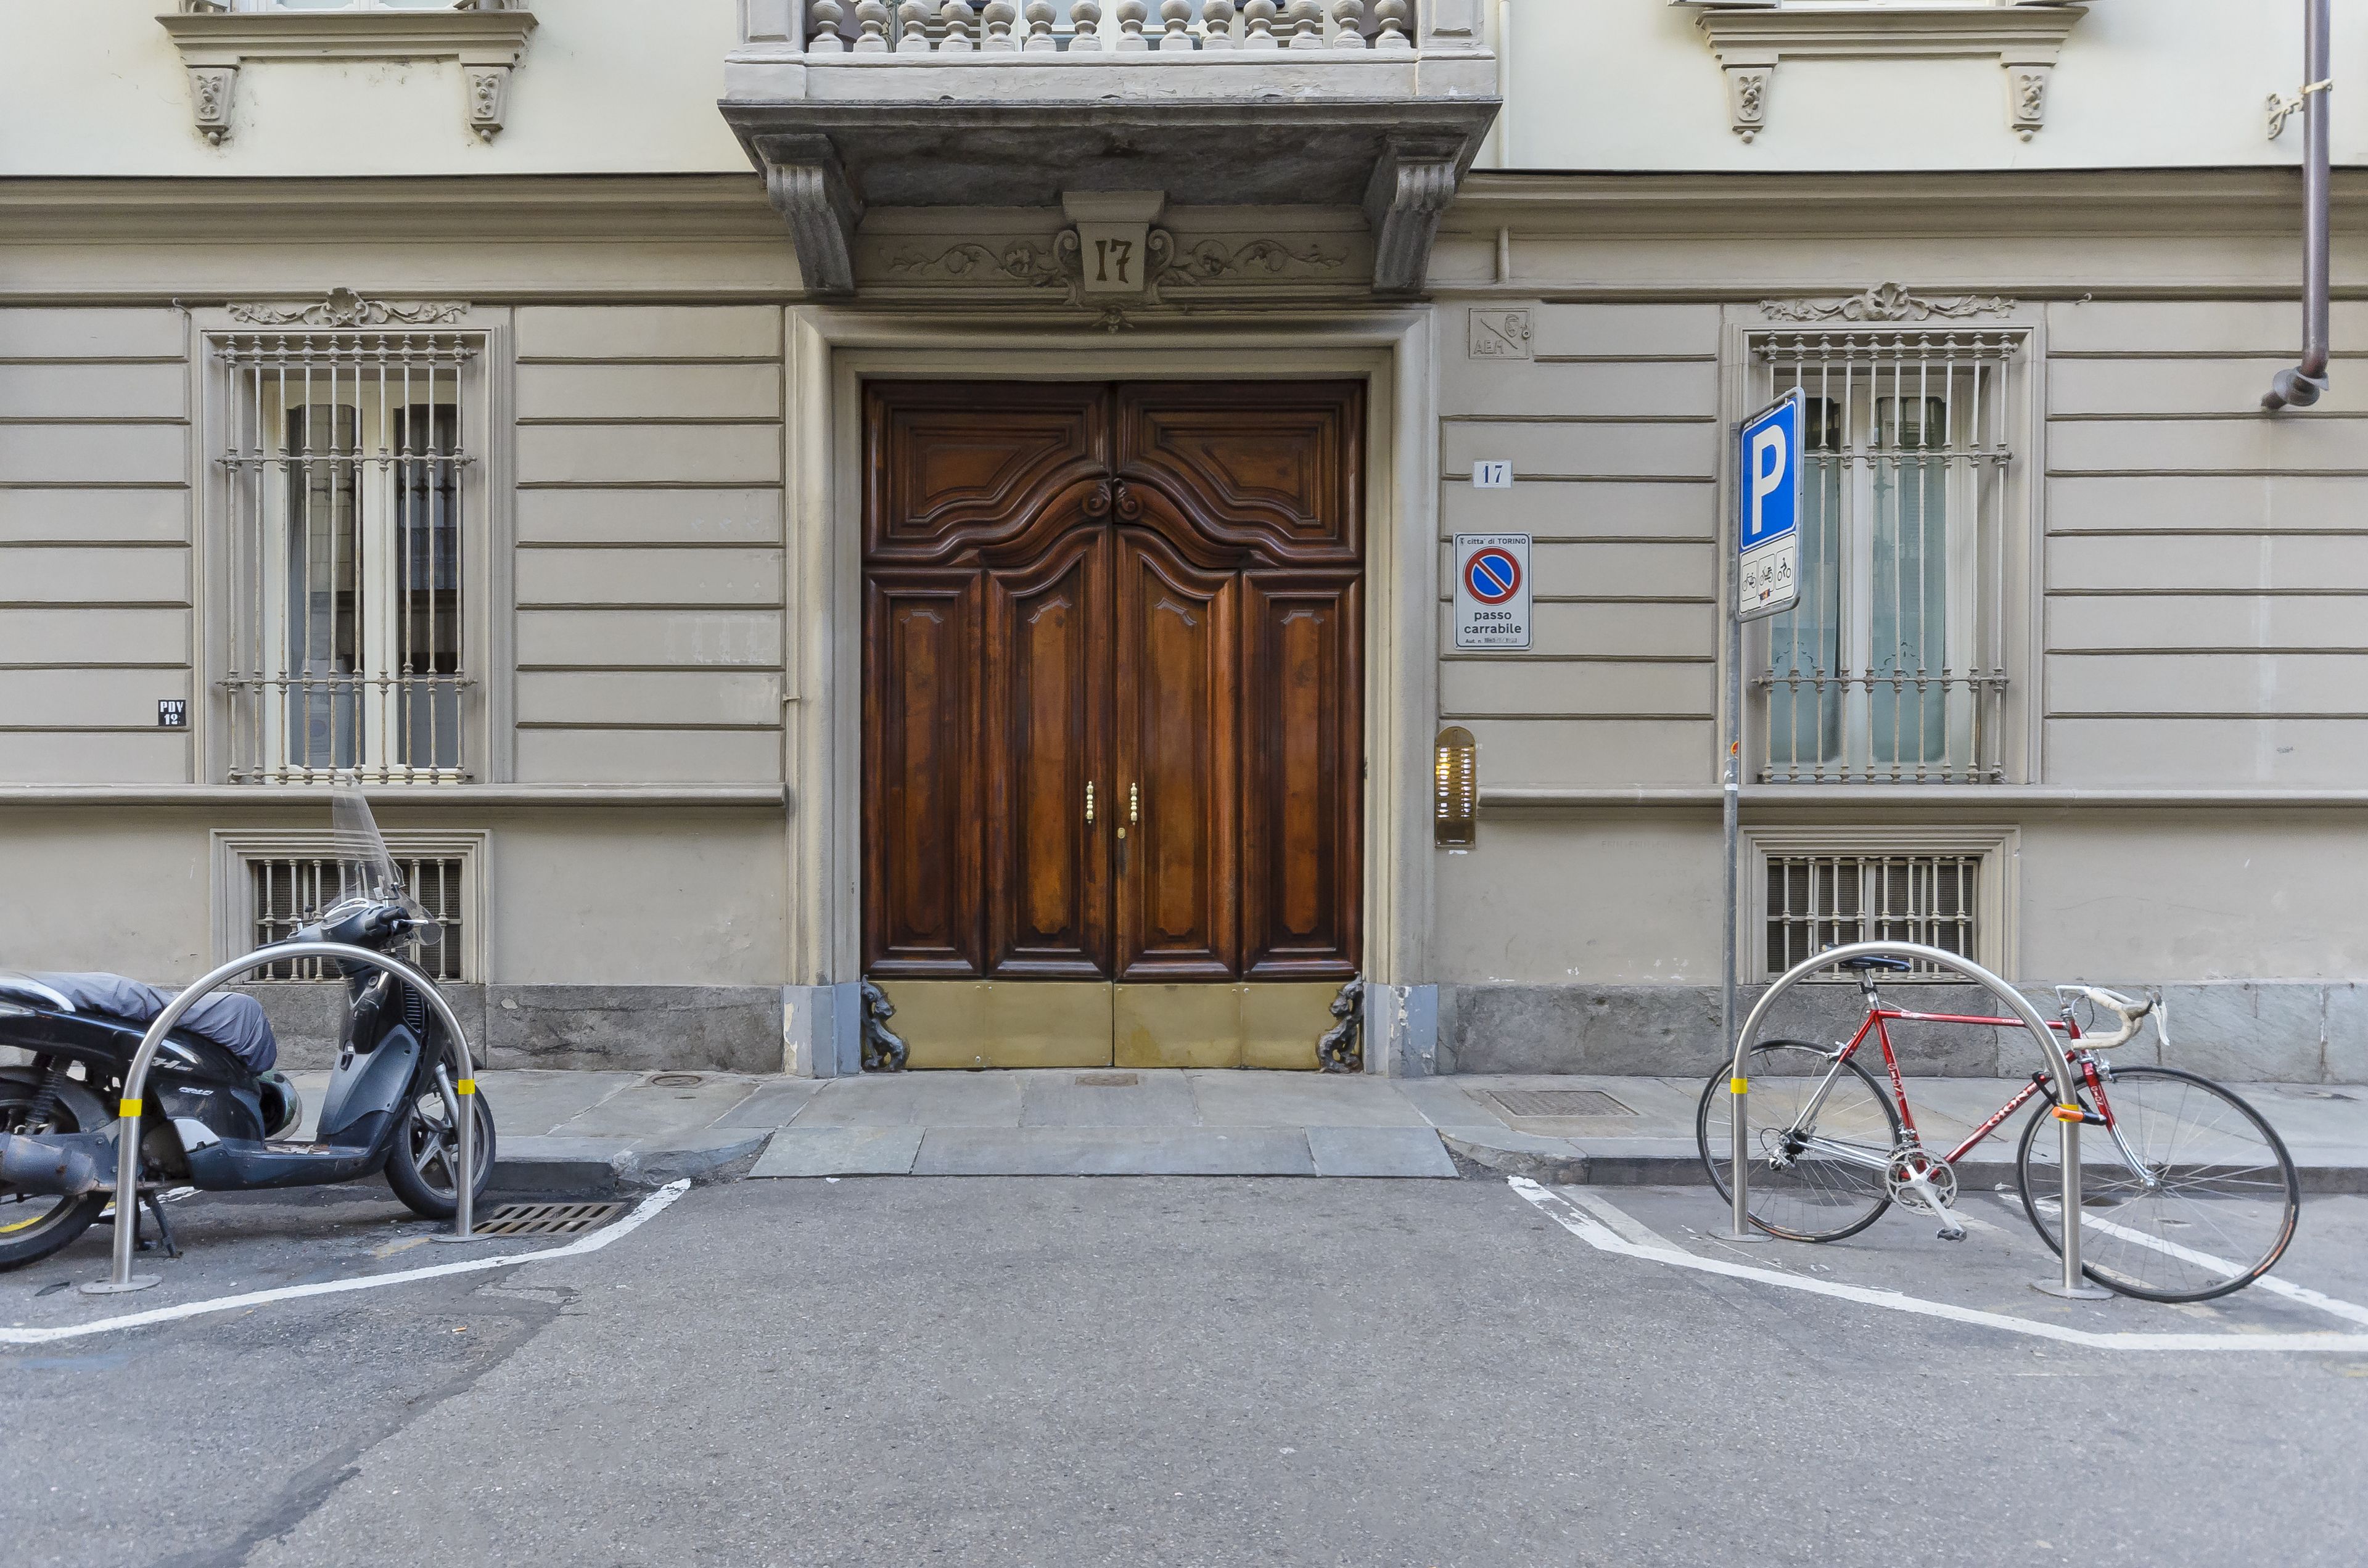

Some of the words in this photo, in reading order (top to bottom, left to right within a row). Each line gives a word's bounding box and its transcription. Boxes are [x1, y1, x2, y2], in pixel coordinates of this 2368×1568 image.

[1095, 239, 1132, 284] 17
[1473, 340, 1504, 354] AEM
[1482, 463, 1503, 483] 17
[1752, 424, 1786, 535] P
[1474, 612, 1512, 622] passo
[1464, 623, 1522, 634] carrabile
[160, 701, 184, 712] PDV
[164, 713, 178, 725] 12
